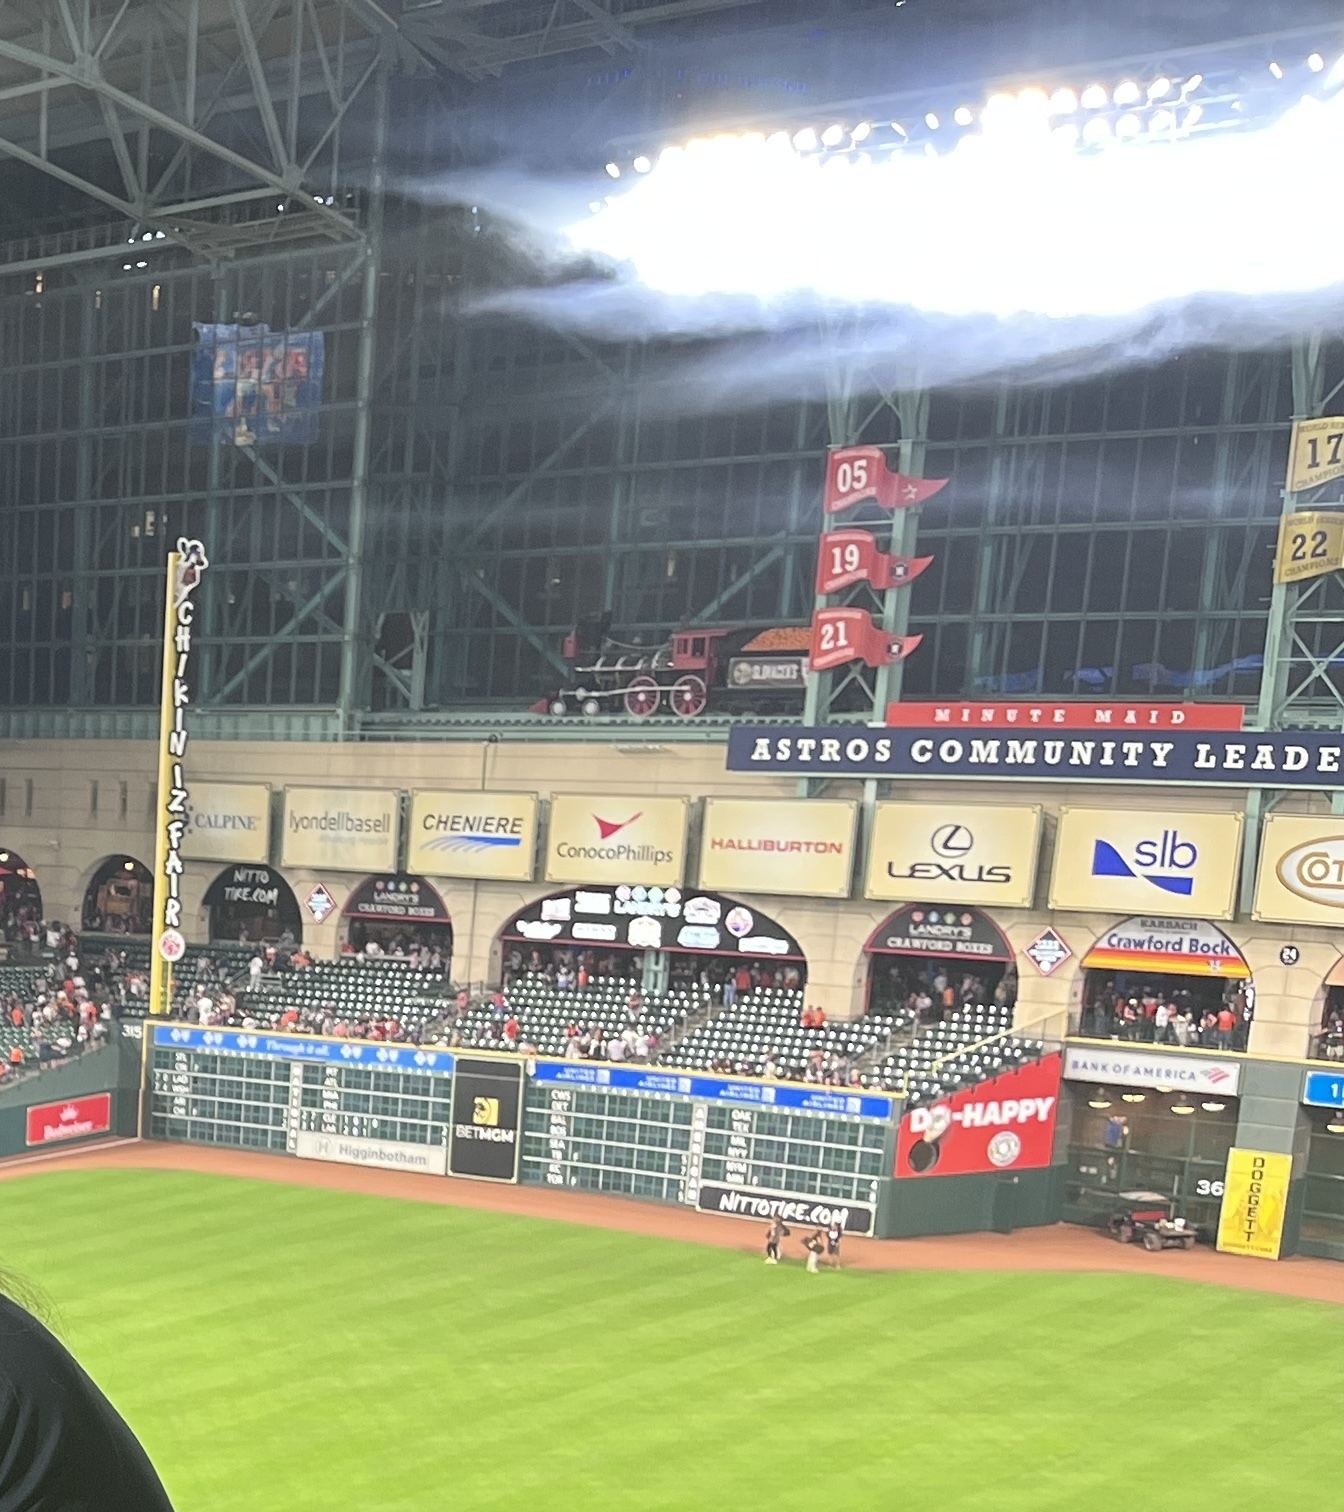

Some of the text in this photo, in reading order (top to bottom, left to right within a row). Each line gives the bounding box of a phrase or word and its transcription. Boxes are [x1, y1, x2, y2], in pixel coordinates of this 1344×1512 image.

[1307, 433, 1344, 469] 17
[837, 459, 868, 493] 05
[1291, 530, 1328, 562] 22
[831, 544, 860, 574] 19
[820, 621, 848, 650] 21
[169, 601, 194, 757] CHIKIN
[934, 708, 1186, 725] MINUTE MAID
[751, 738, 1341, 772] ASTROS COMMUNITY LEADE
[195, 813, 256, 831] CALPINE
[289, 809, 391, 834] lyondellbasell
[422, 814, 524, 834] CHENIERE
[557, 842, 673, 866] ConocoPhillips
[711, 838, 843, 854] HALLIBURTON
[1135, 830, 1197, 869] slb
[165, 821, 184, 927] FAIR
[233, 869, 270, 885] NITTO
[888, 861, 1011, 883] LEXUS
[909, 924, 972, 938] LANDRY'S
[1140, 919, 1198, 931] KARBACH
[886, 936, 953, 951] CRAWFORD
[1107, 932, 1231, 956] Crawford Bock
[122, 1025, 142, 1039] 315
[1072, 1060, 1197, 1081] BANK OF AMERICA
[456, 1124, 515, 1144] BETMGM
[339, 1144, 428, 1166] Higginbotham
[719, 1191, 849, 1231] NITTOTIRE.COM
[1243, 1157, 1266, 1242] DOGGETT
